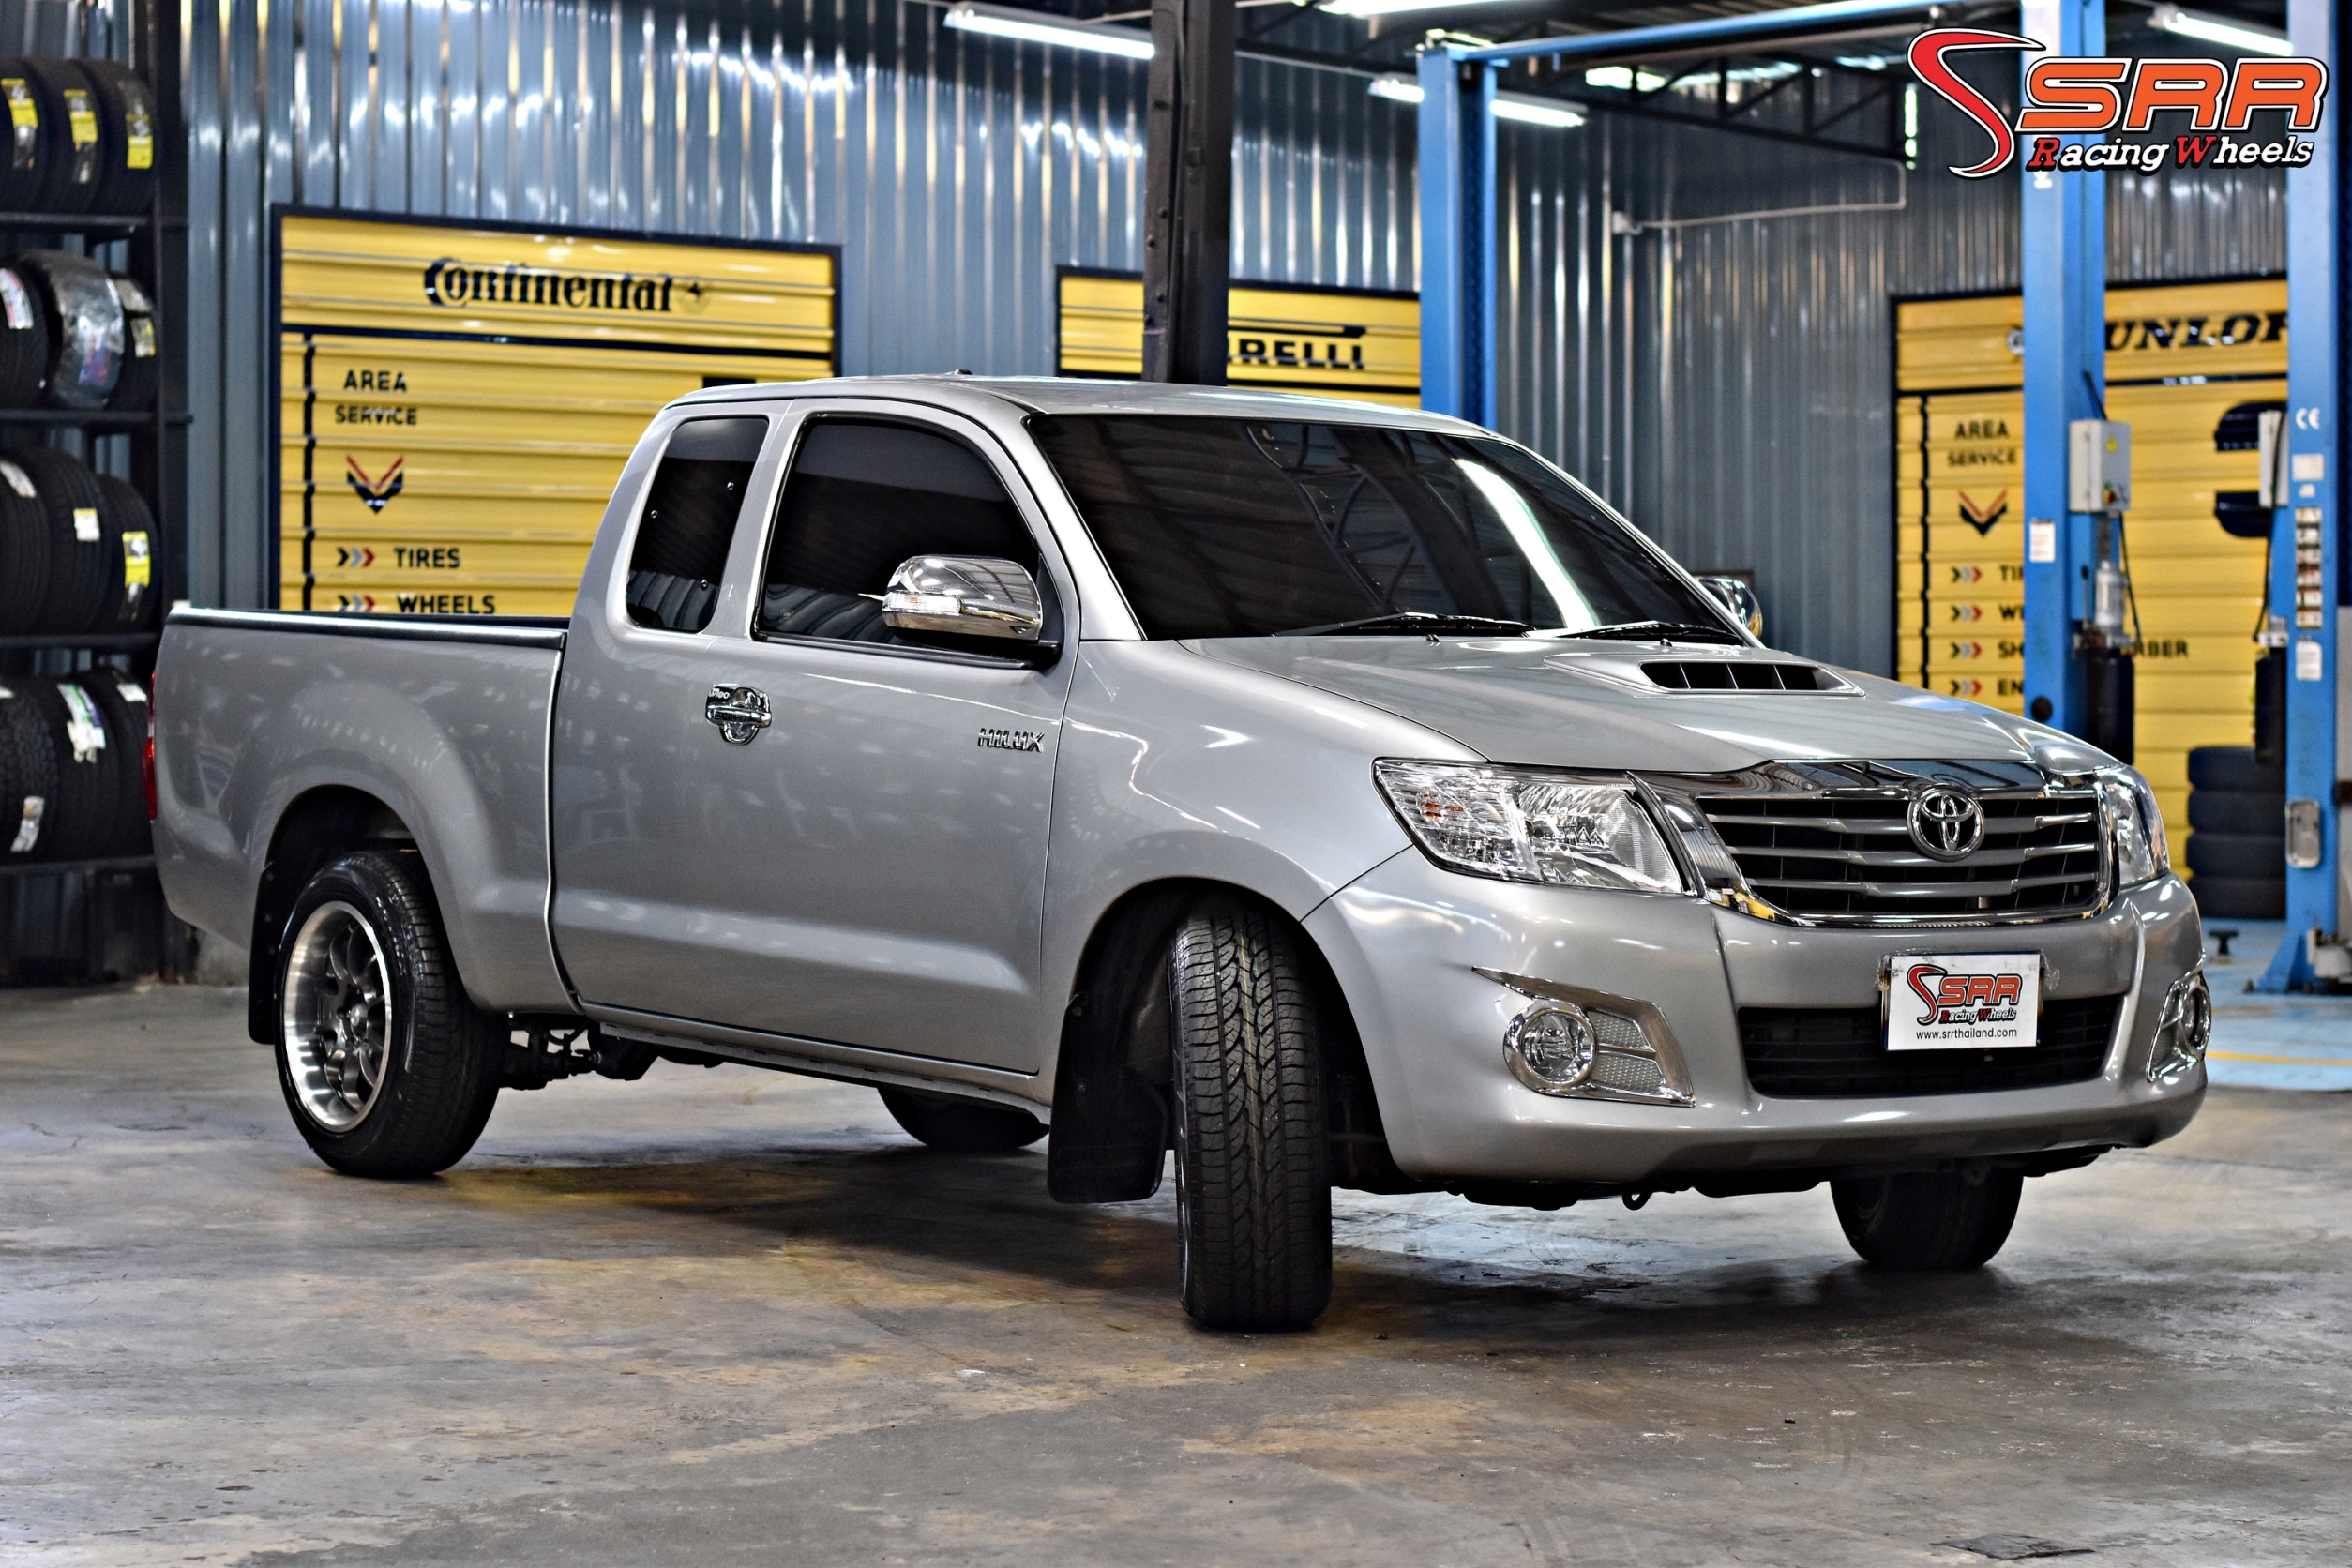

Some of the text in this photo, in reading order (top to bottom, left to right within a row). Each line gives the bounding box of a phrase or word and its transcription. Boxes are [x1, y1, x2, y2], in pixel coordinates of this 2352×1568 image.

[424, 257, 674, 311] Continental
[1228, 326, 1364, 369] RELLI
[343, 369, 408, 392] AREA
[335, 404, 418, 426] SERVICE
[1954, 419, 2011, 440] AREA
[394, 547, 461, 569] TIRES
[396, 593, 496, 614] WHEELS
[977, 728, 1045, 753] HILUX
[1938, 1006, 2017, 1025] Racing Wheels
[1916, 1027, 2017, 1040] www.srrthailand.com
